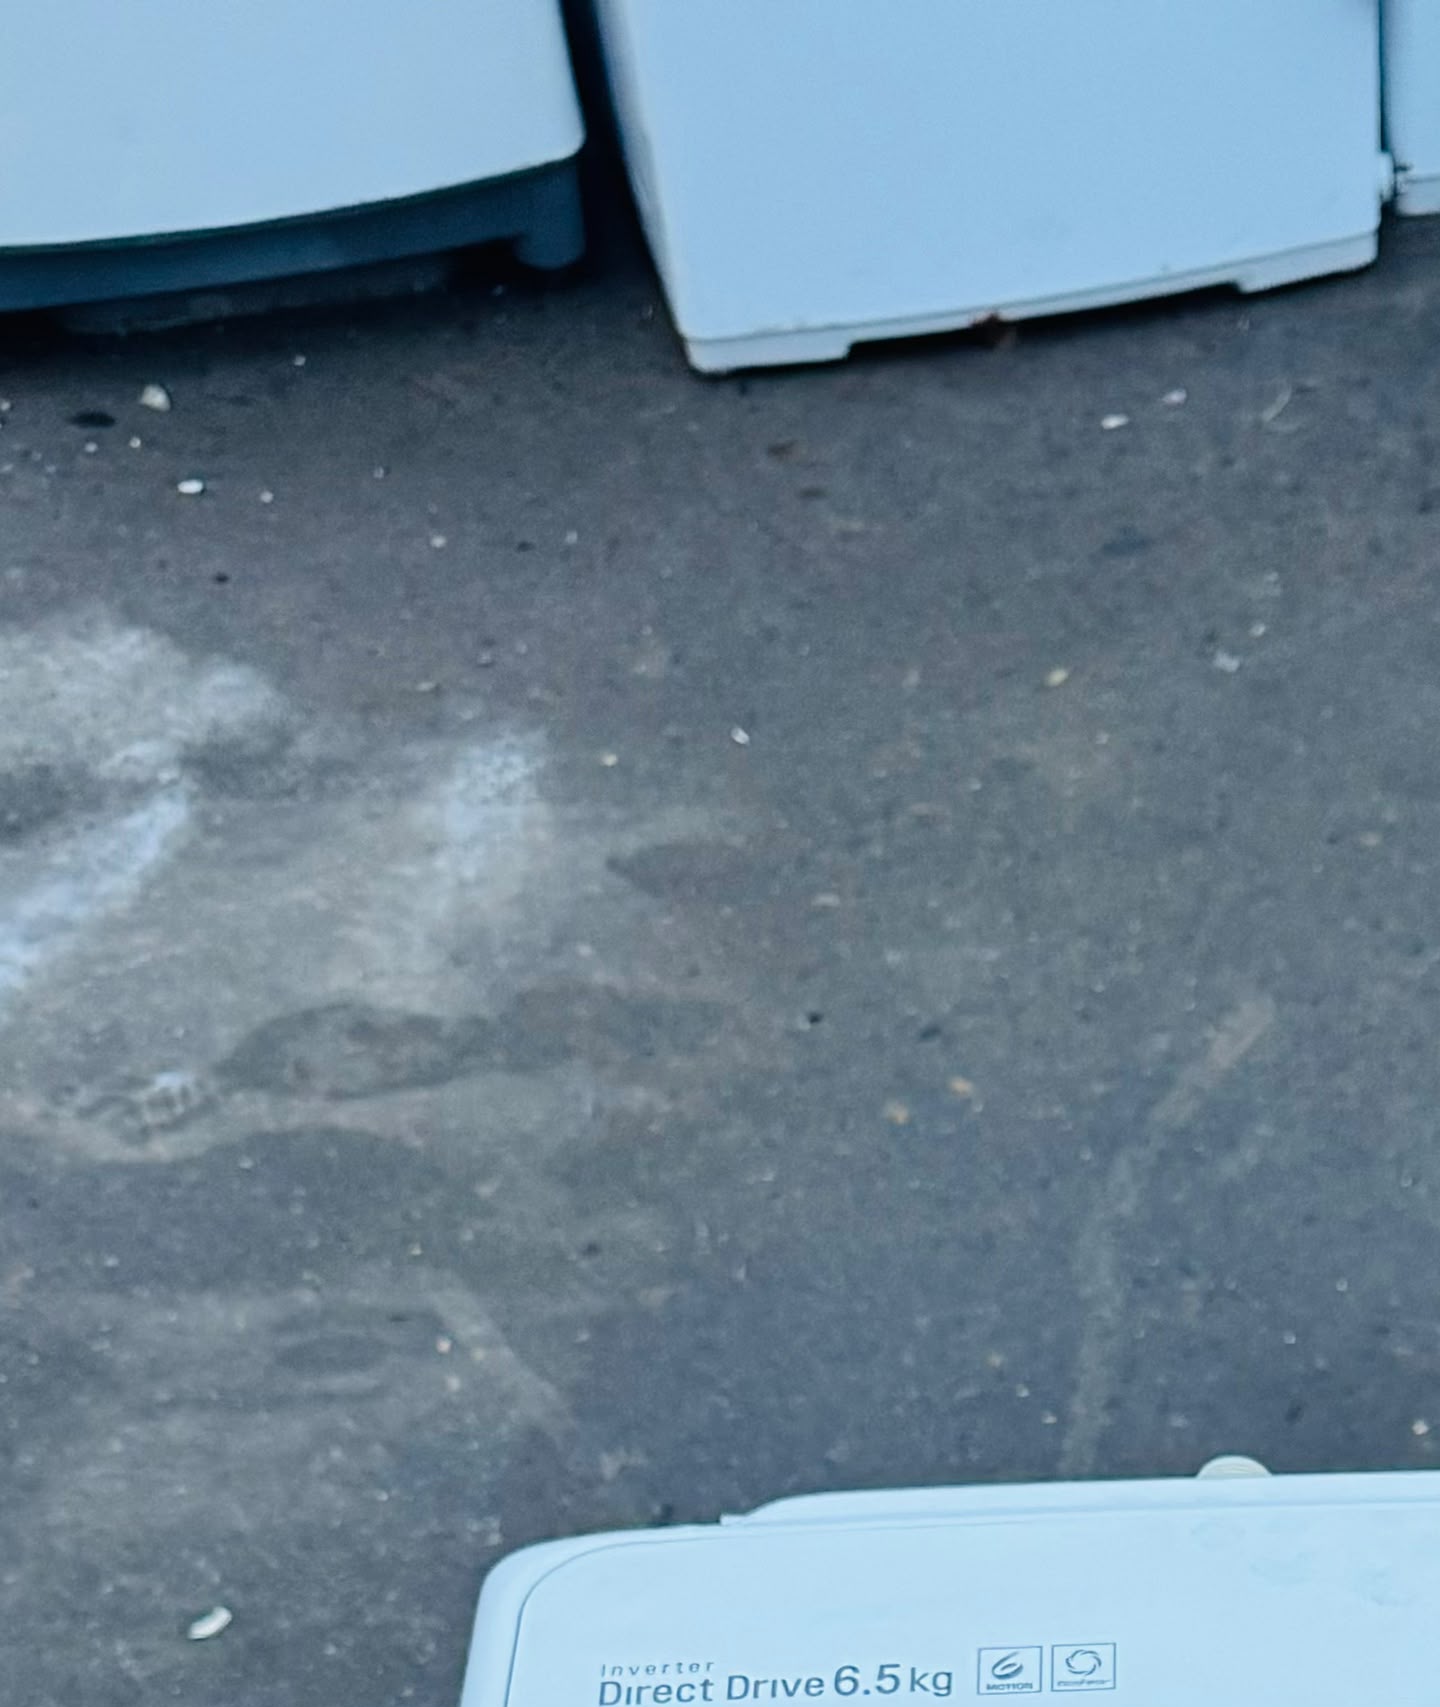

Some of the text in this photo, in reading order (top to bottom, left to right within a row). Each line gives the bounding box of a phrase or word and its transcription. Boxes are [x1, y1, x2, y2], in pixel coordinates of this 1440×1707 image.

[601, 1662, 714, 1677] Inverter
[599, 1677, 715, 1706] Direct
[727, 1674, 825, 1700] Drive
